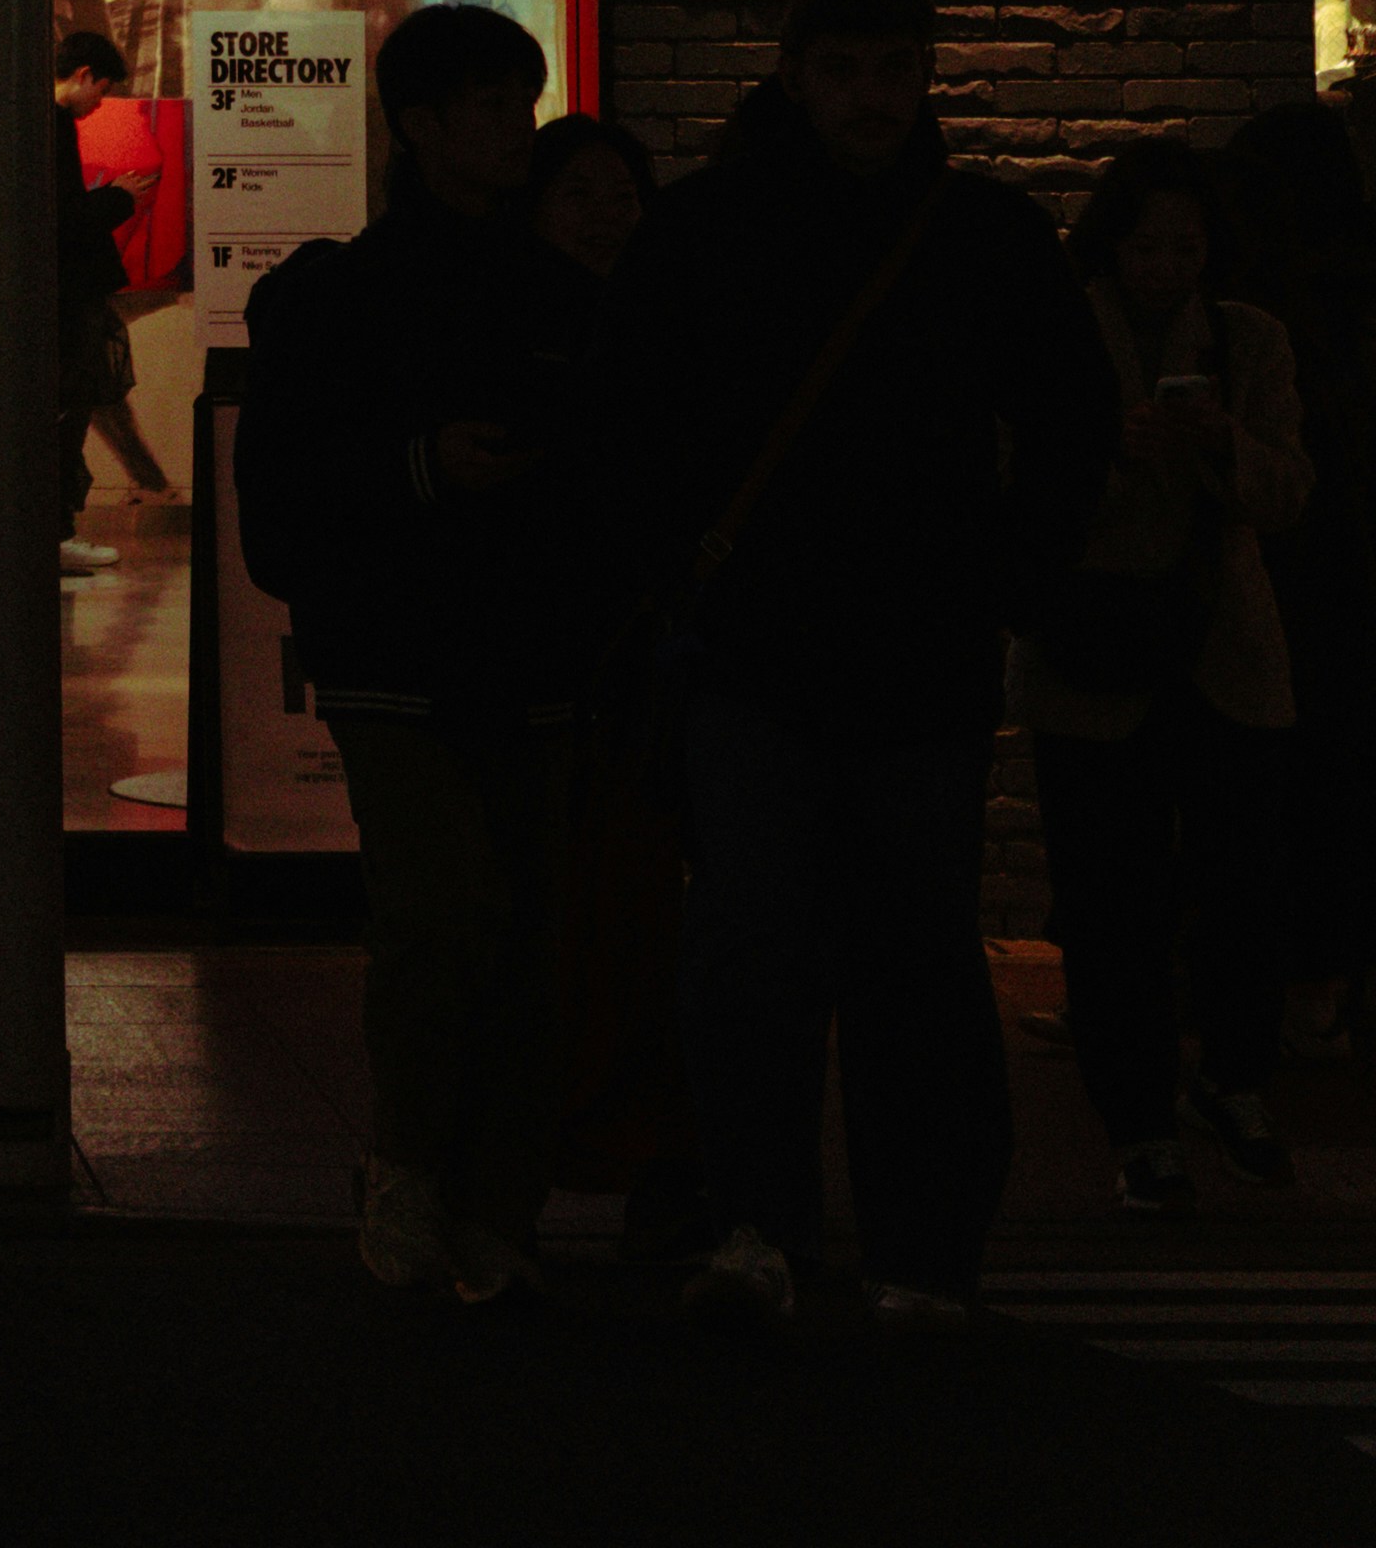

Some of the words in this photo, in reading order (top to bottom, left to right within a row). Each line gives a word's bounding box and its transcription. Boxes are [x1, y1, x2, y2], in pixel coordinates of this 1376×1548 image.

[210, 31, 289, 57] STORE
[210, 58, 352, 84] DIRECTORY
[210, 89, 236, 111] 3F
[240, 89, 262, 99] Men
[240, 104, 274, 114] Jordan
[240, 118, 295, 128] Basketball
[211, 167, 238, 189] 2F
[241, 168, 279, 177] Women
[241, 183, 263, 192] Kids
[211, 246, 233, 268] 1F
[241, 246, 282, 257] Running
